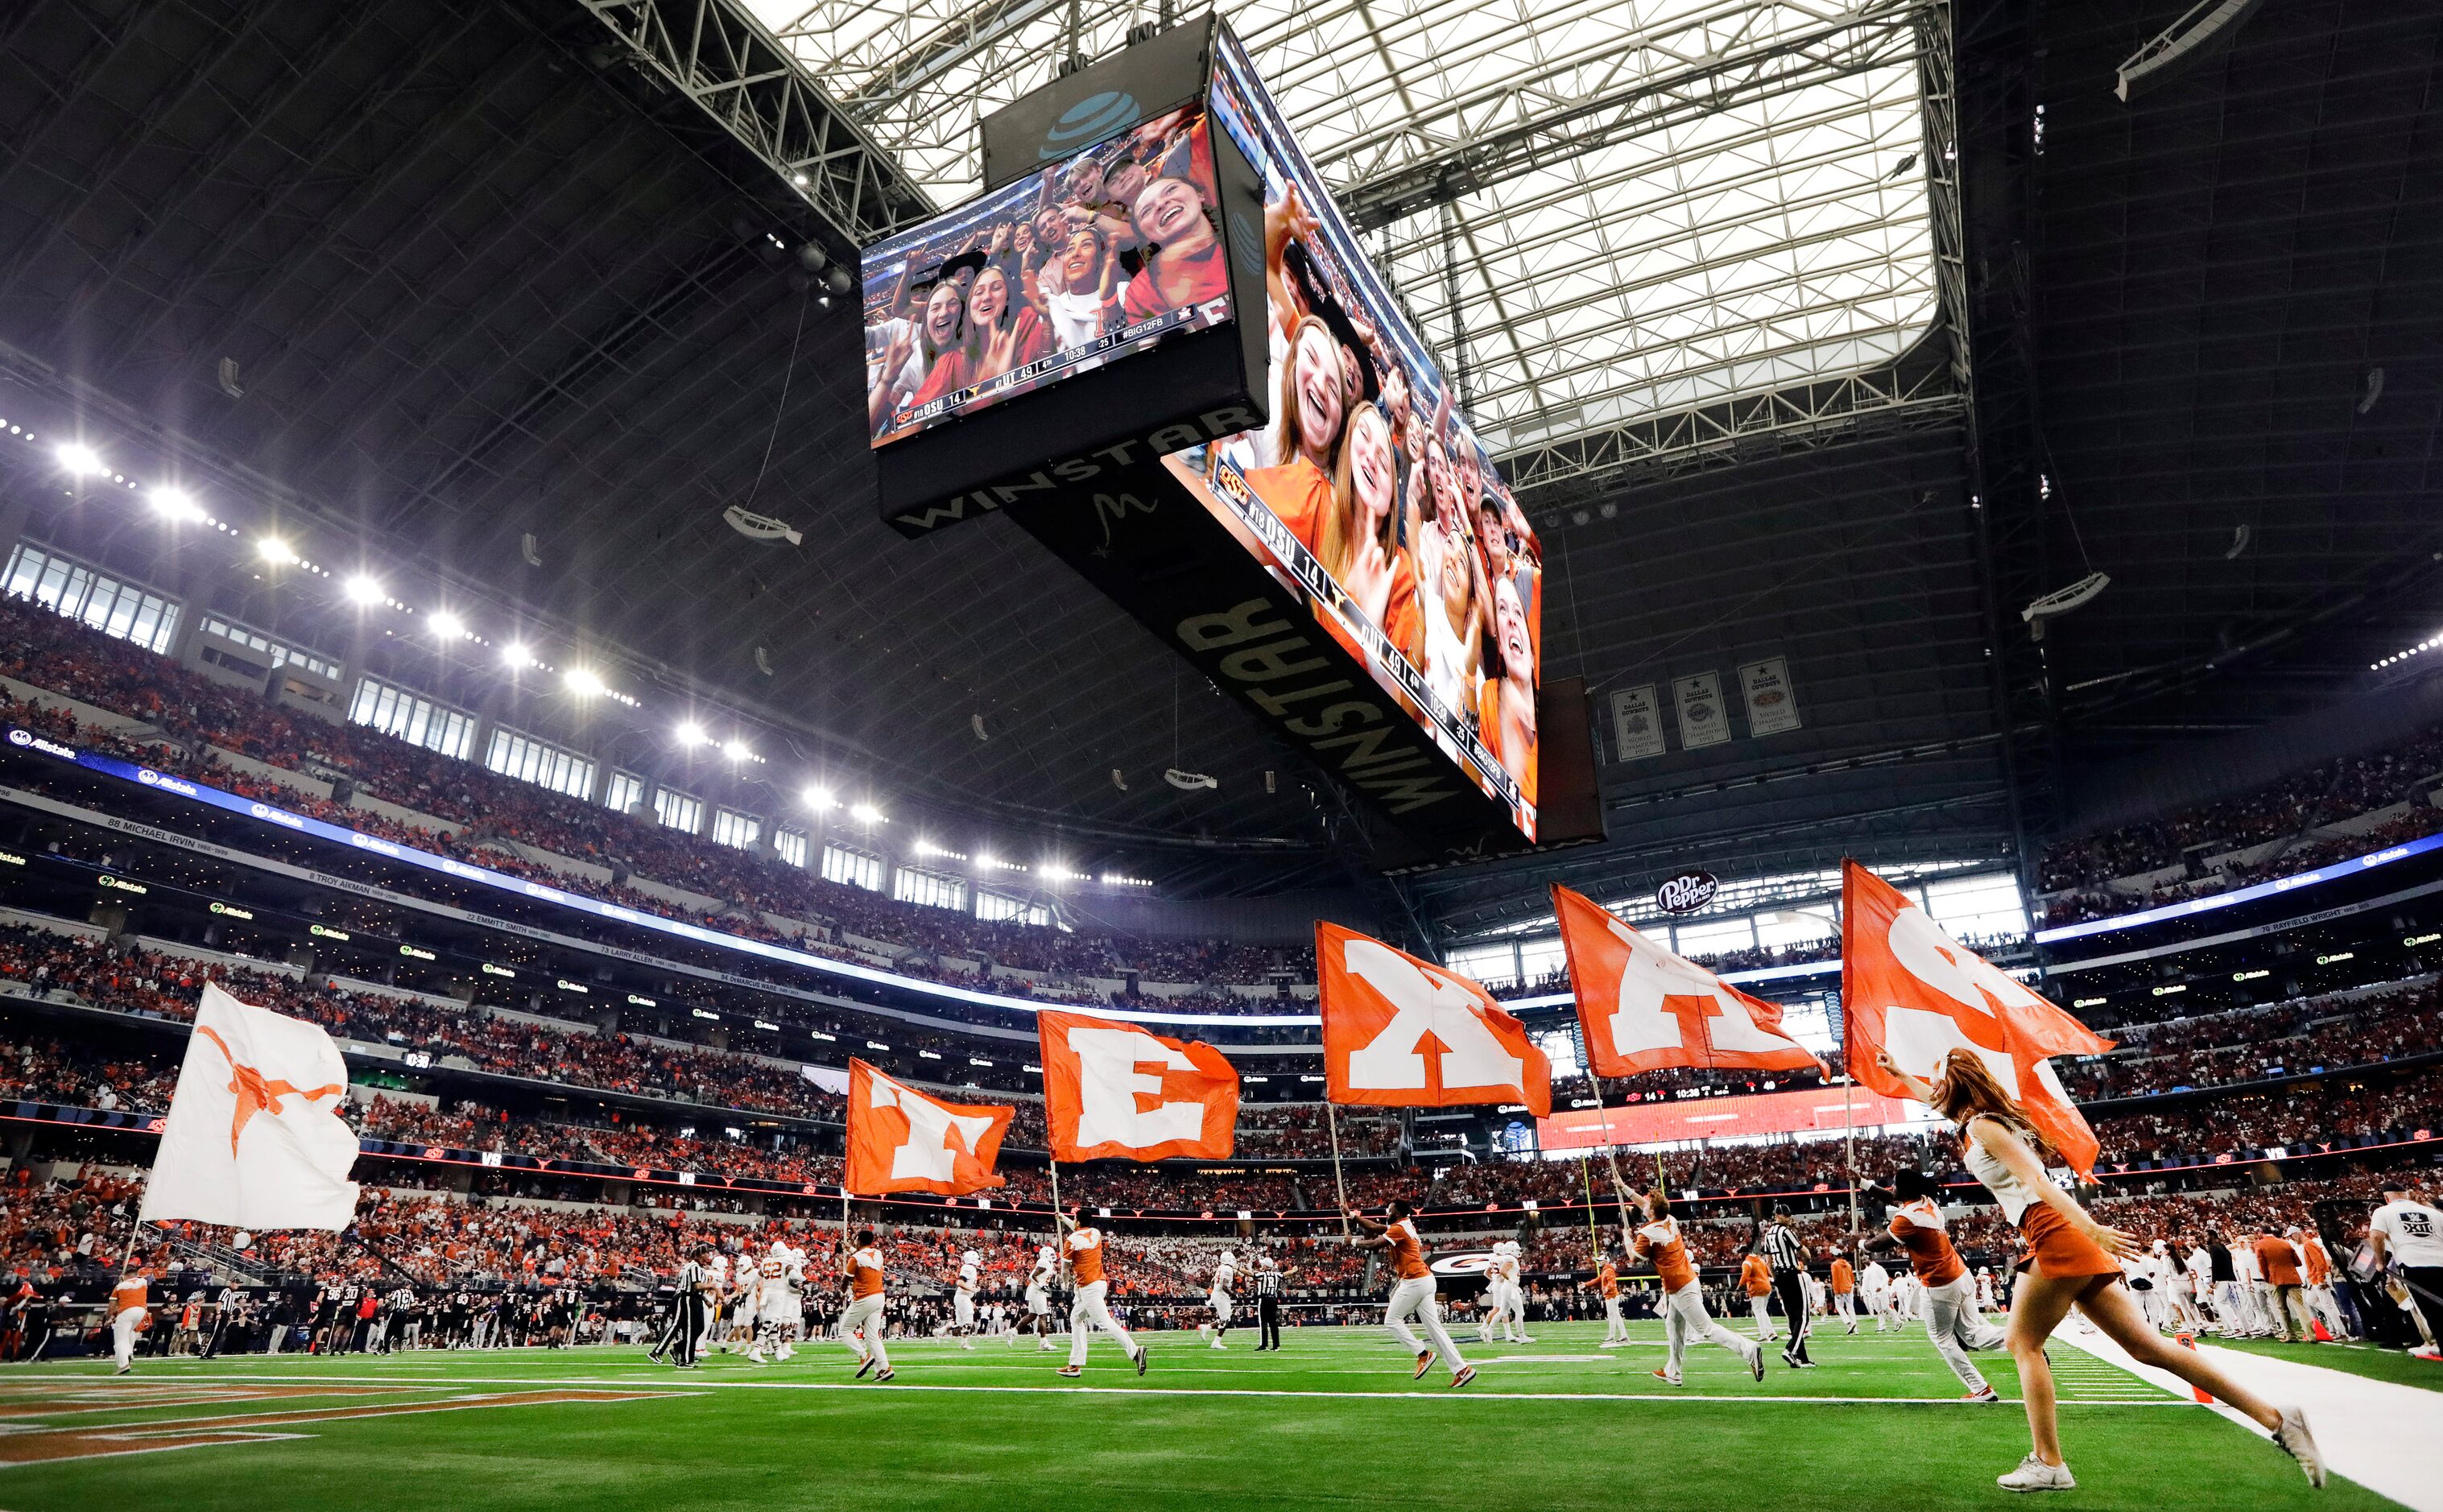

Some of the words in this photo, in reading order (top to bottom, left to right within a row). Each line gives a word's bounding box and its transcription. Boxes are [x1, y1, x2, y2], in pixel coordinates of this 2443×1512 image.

[924, 399, 944, 416] OSU
[949, 393, 961, 406] 14
[1002, 373, 1015, 386] UT
[1020, 368, 1032, 379] 49
[1064, 346, 1086, 361] 10:38
[1098, 338, 1109, 349] :25
[1123, 318, 1164, 339] #BIG12FB
[895, 406, 1259, 529] WINSTAR
[1249, 502, 1265, 529] #18
[1266, 515, 1296, 562] OSU
[1304, 556, 1318, 589] 14
[1370, 626, 1384, 658] UT
[1389, 650, 1401, 676] 49
[1430, 692, 1448, 724] 10:38
[1457, 725, 1465, 742] :25
[1474, 743, 1501, 779] #BIG12FB
[1684, 694, 1713, 704] COWBOYS
[1686, 688, 1709, 697] DALLAS
[1176, 597, 1460, 815] WINSTAR
[1622, 706, 1649, 716] COWBOYS
[1623, 701, 1646, 709] DALLAS
[108, 818, 121, 828] 88
[122, 822, 167, 841] MICHAEL
[169, 834, 195, 848] IRVIN
[114, 880, 147, 894] Allstate
[316, 874, 338, 886] TROY
[340, 879, 370, 895] AIKMAN
[1678, 876, 1700, 893] Dr
[223, 907, 253, 920] Allstate
[2273, 917, 2309, 931] RAYFIELD
[2310, 909, 2342, 922] WRIGHT
[466, 913, 475, 922] 22
[477, 915, 505, 930] EMMITT
[506, 922, 527, 934] SMITH
[2416, 932, 2441, 944] Allstate
[610, 949, 632, 958] LARRY
[632, 955, 653, 964] ALLEN
[730, 976, 760, 988] DeMARCUS
[1608, 915, 1810, 1057] A
[1344, 940, 1524, 1093] X
[406, 1053, 430, 1069] 10:38
[1068, 1027, 1205, 1148] E
[1676, 1088, 1700, 1098] 10:38
[1645, 1092, 1656, 1101] 14
[867, 1069, 994, 1183] T
[482, 1151, 502, 1167] VS
[2264, 1147, 2287, 1160] VS
[679, 1171, 695, 1186] VS
[1682, 1191, 1699, 1201] VS
[763, 1262, 782, 1279] 52
[1267, 1277, 1275, 1287] R
[327, 1288, 341, 1300] 96
[344, 1288, 358, 1299] 30
[402, 1293, 410, 1303] C
[507, 1295, 515, 1304] 4
[567, 1292, 576, 1304] 8
